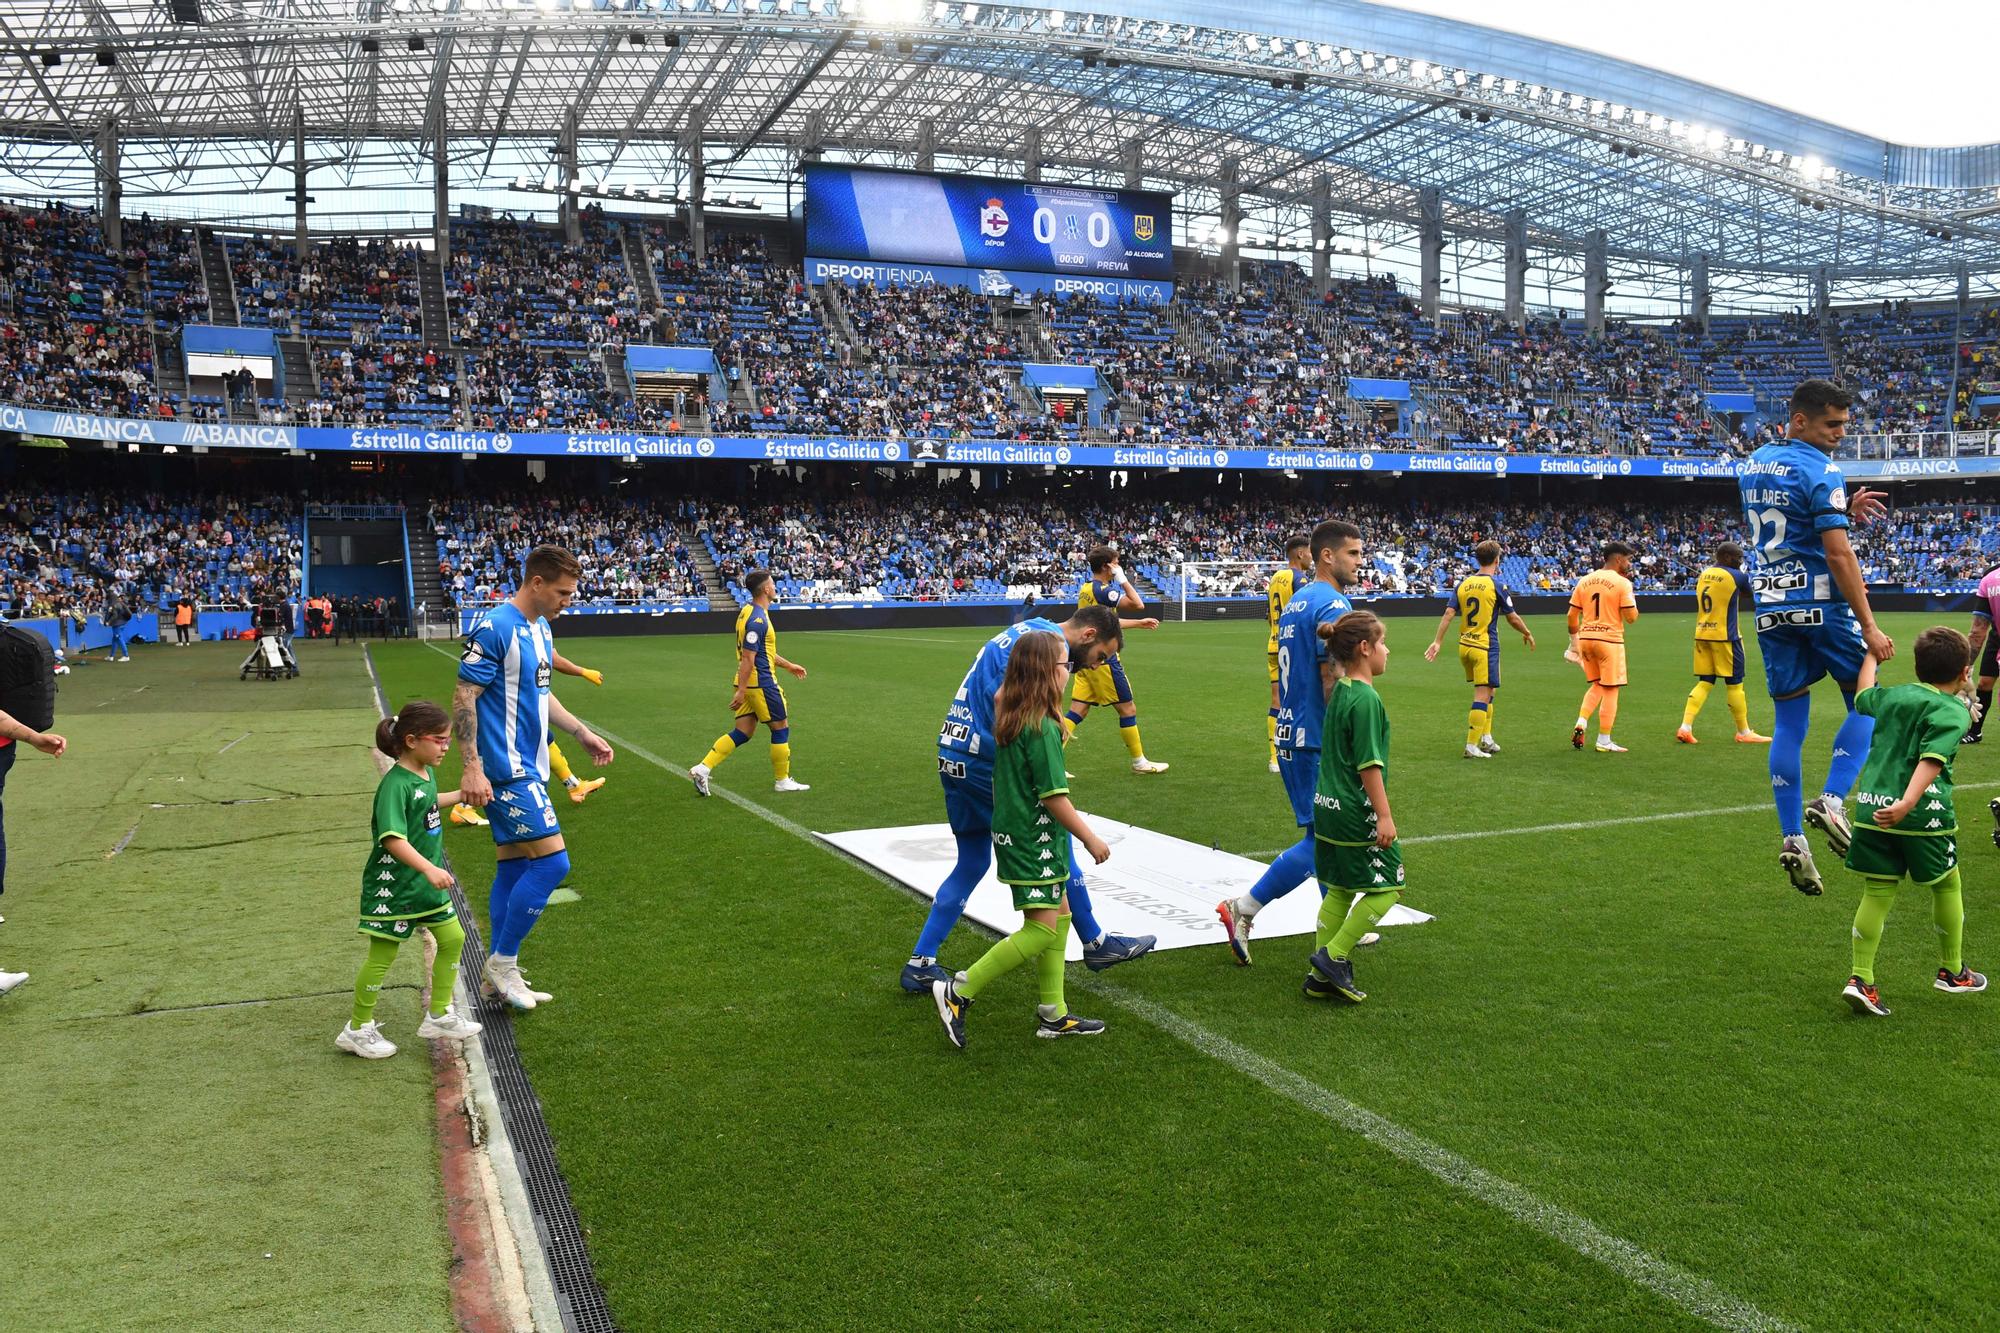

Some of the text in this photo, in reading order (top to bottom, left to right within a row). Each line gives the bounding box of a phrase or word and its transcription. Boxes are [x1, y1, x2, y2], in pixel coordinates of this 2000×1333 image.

[1033, 208, 1056, 244] 0
[1088, 212, 1110, 248] 0
[1060, 254, 1084, 264] 00:00
[1096, 261, 1129, 271] PREVIA
[350, 430, 488, 450] Estrella Galicia
[566, 437, 692, 454] Estrella Galicia
[764, 441, 880, 459] Estrella Galicia
[946, 446, 1000, 462] Estrella
[1003, 446, 1052, 462] Galicia
[1113, 450, 1211, 466] Estrella Galicia
[1267, 452, 1357, 468] Estrella Galicia
[1409, 456, 1492, 470] Estrella Galicia
[1540, 459, 1618, 473] Estrella Galicia
[1662, 462, 1734, 475] Estrella Galicia
[1752, 573, 1808, 592] DIGI
[1590, 592, 1600, 621] 1
[1701, 586, 1712, 613] 6
[1466, 596, 1480, 627] 2
[1756, 608, 1824, 632] DIGI
